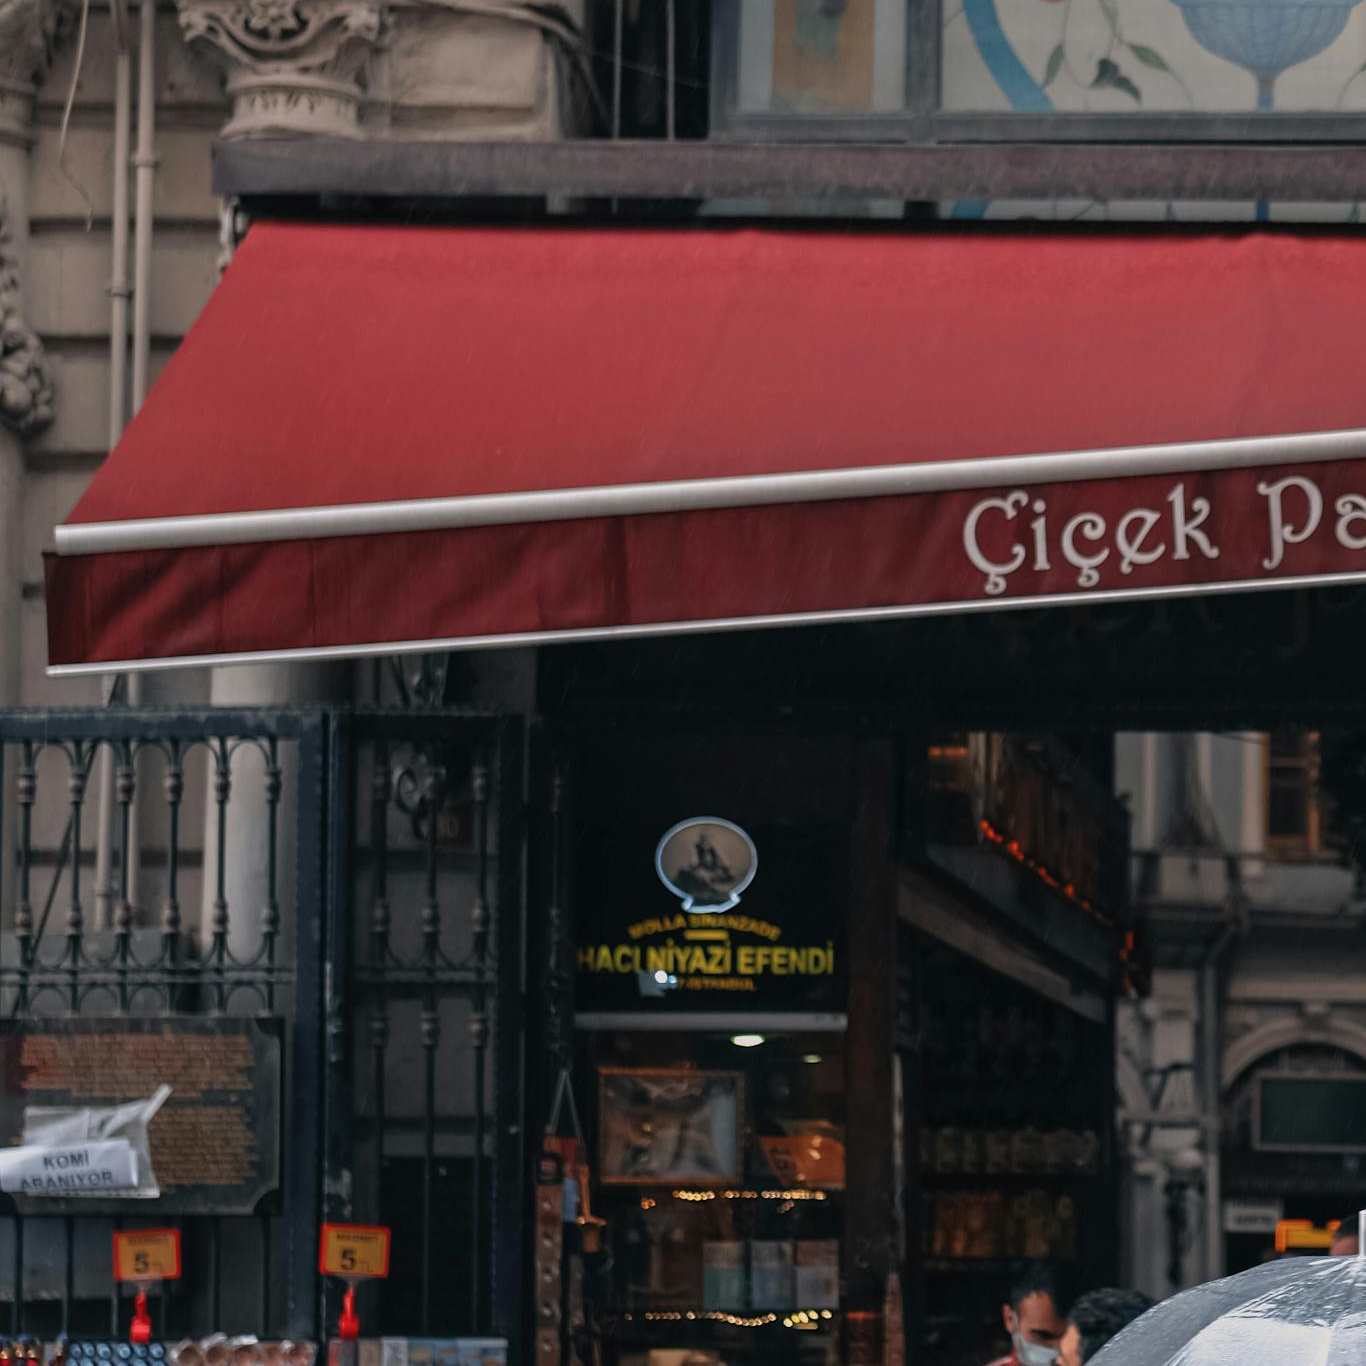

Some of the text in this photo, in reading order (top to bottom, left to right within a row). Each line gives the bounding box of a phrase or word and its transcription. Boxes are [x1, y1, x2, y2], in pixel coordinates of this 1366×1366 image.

[962, 483, 1220, 596] Çiçek
[646, 937, 731, 974] NİYAZİ
[737, 941, 834, 975] EFENDİ
[43, 1150, 90, 1170] KOMİ
[134, 1251, 150, 1274] 5
[341, 1247, 356, 1271] 5
